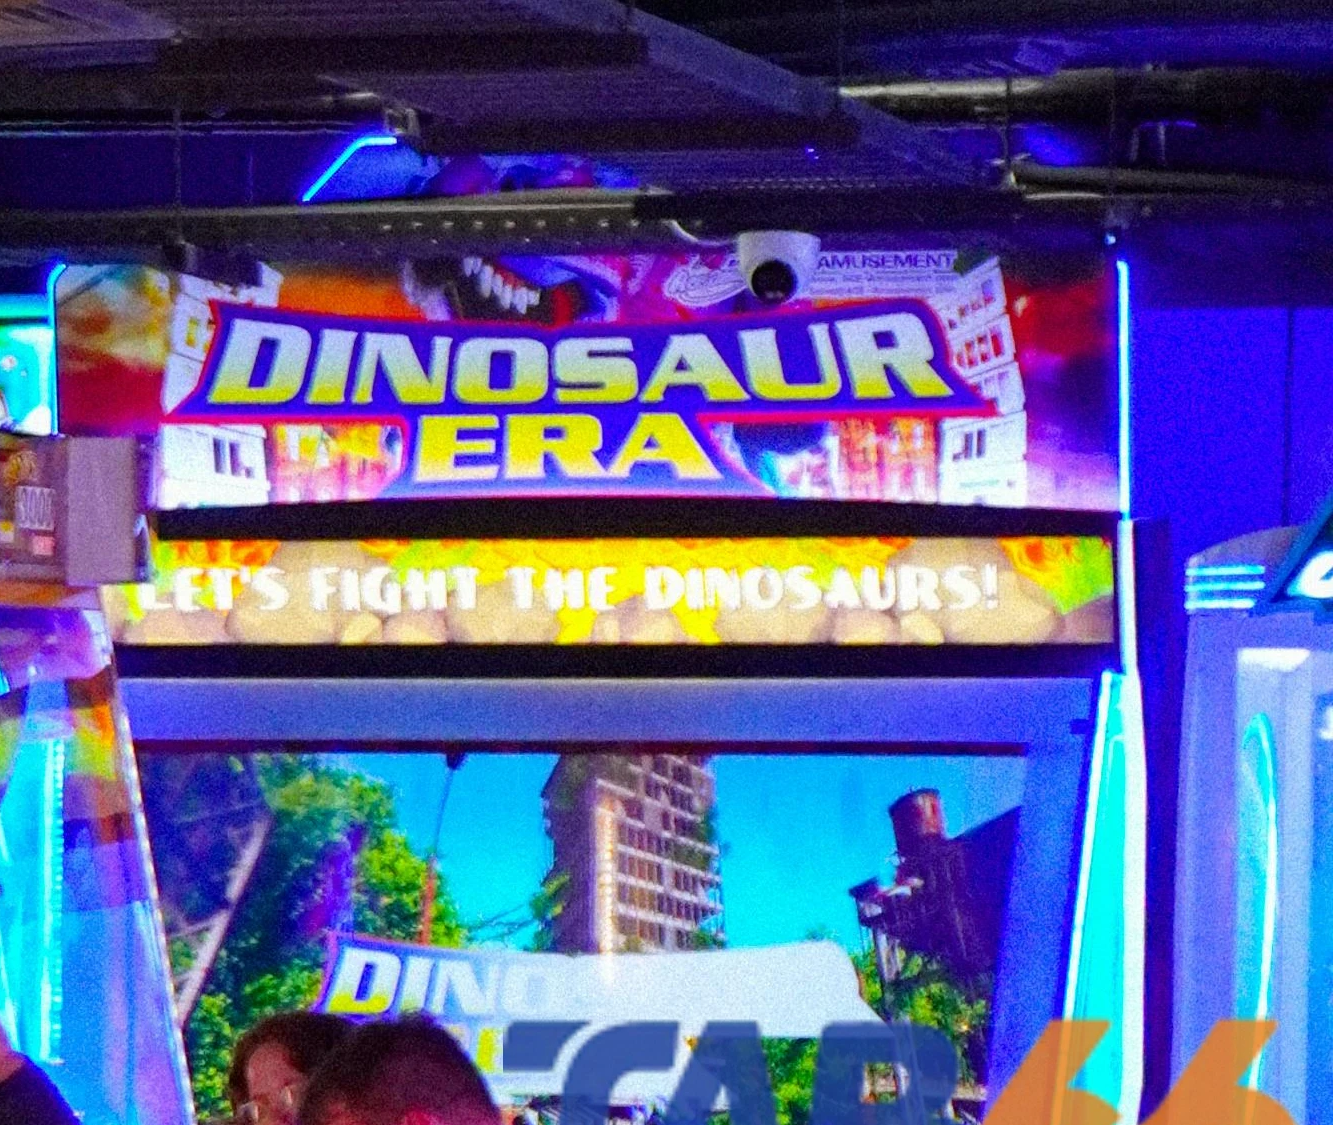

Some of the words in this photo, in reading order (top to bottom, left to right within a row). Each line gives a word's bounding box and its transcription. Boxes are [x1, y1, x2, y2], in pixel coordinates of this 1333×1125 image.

[206, 312, 954, 406] DINOSAUR
[413, 412, 720, 483] ERA
[136, 565, 290, 612] LET'S
[309, 565, 479, 614] FIGHT
[505, 565, 618, 611] THE
[644, 564, 999, 612] DINOSAURS!
